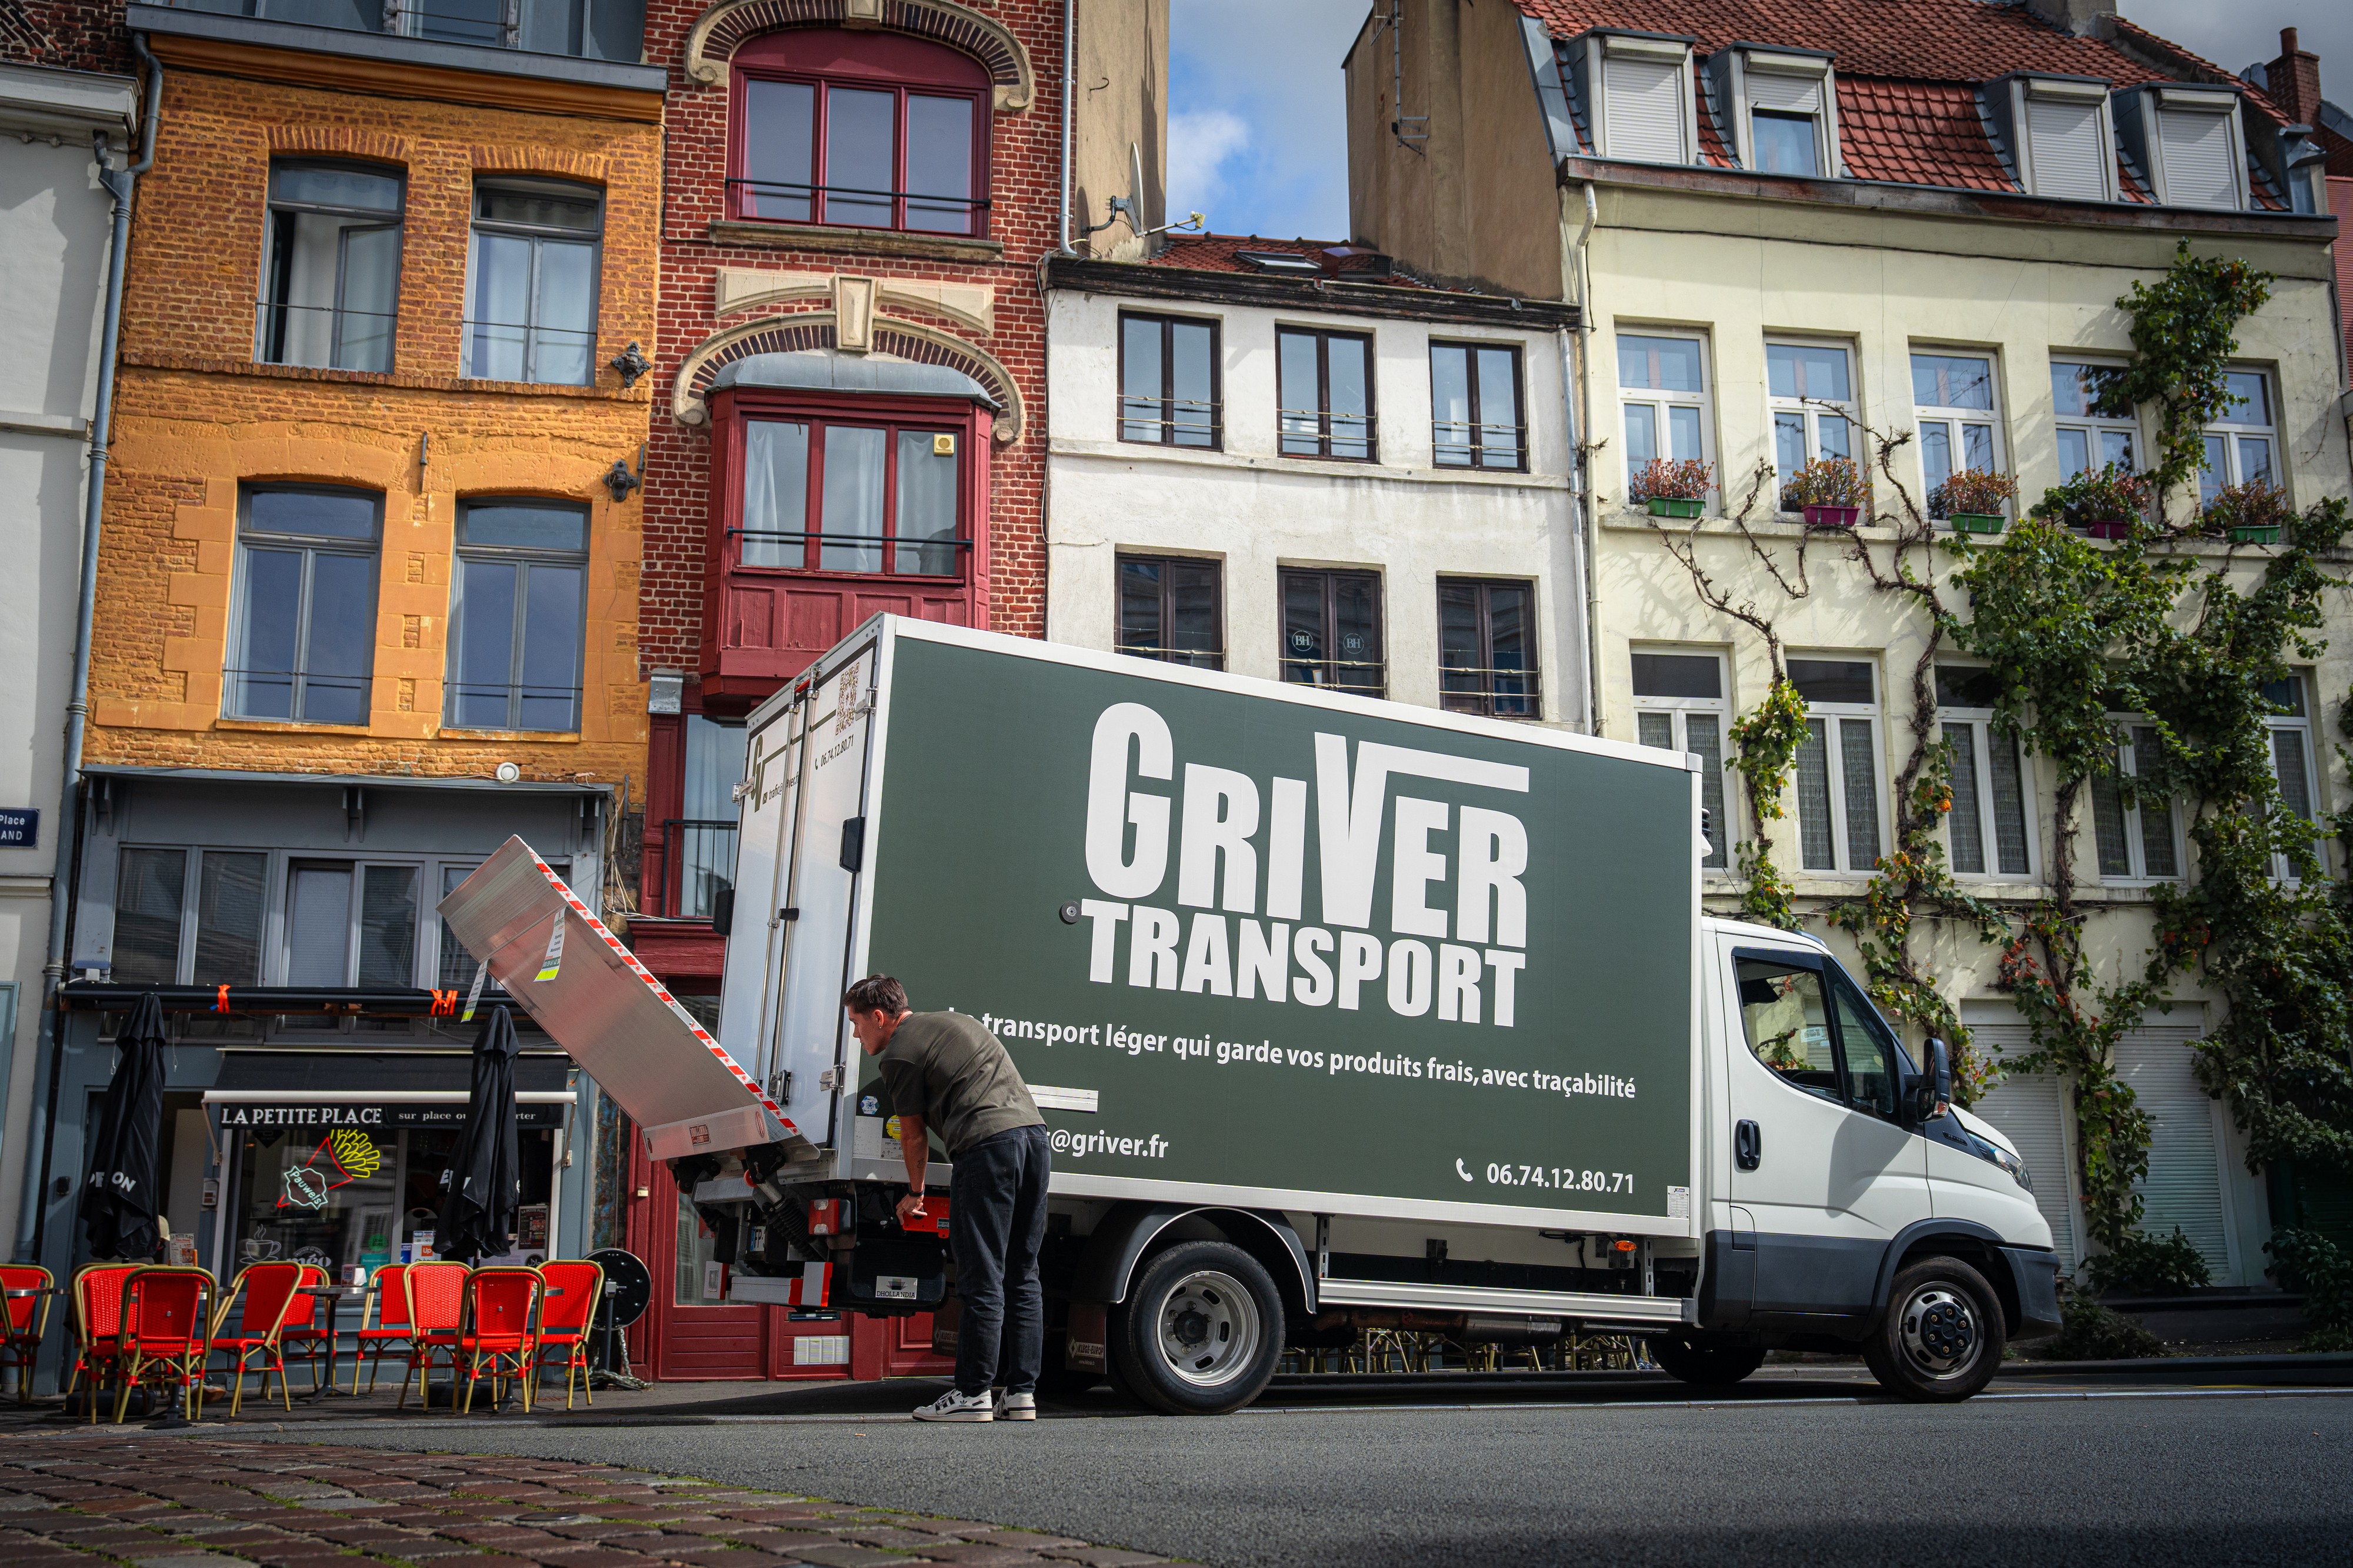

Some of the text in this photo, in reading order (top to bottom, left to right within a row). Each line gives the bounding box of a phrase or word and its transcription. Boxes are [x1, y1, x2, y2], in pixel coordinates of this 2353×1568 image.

[1295, 635, 1310, 646] BH
[1347, 638, 1361, 648] BH
[821, 733, 854, 767] 06.74.12.80.71
[0, 815, 25, 825] Place
[1085, 702, 1529, 948] GRIVER
[1081, 898, 1526, 1027] TRANSPORT
[982, 1013, 1100, 1046] transport
[1106, 1023, 1167, 1056] léger
[1173, 1034, 1209, 1060] qui
[1217, 1040, 1283, 1065] garde
[1287, 1049, 1324, 1069] vos
[1329, 1051, 1422, 1077] produits
[1533, 1070, 1637, 1099] traçabilité
[221, 1108, 382, 1124] LA PETITE PLACE
[422, 1111, 452, 1122] place
[290, 1170, 322, 1204] Pauwels
[1487, 1163, 1634, 1194] 06.74.12.80.71
